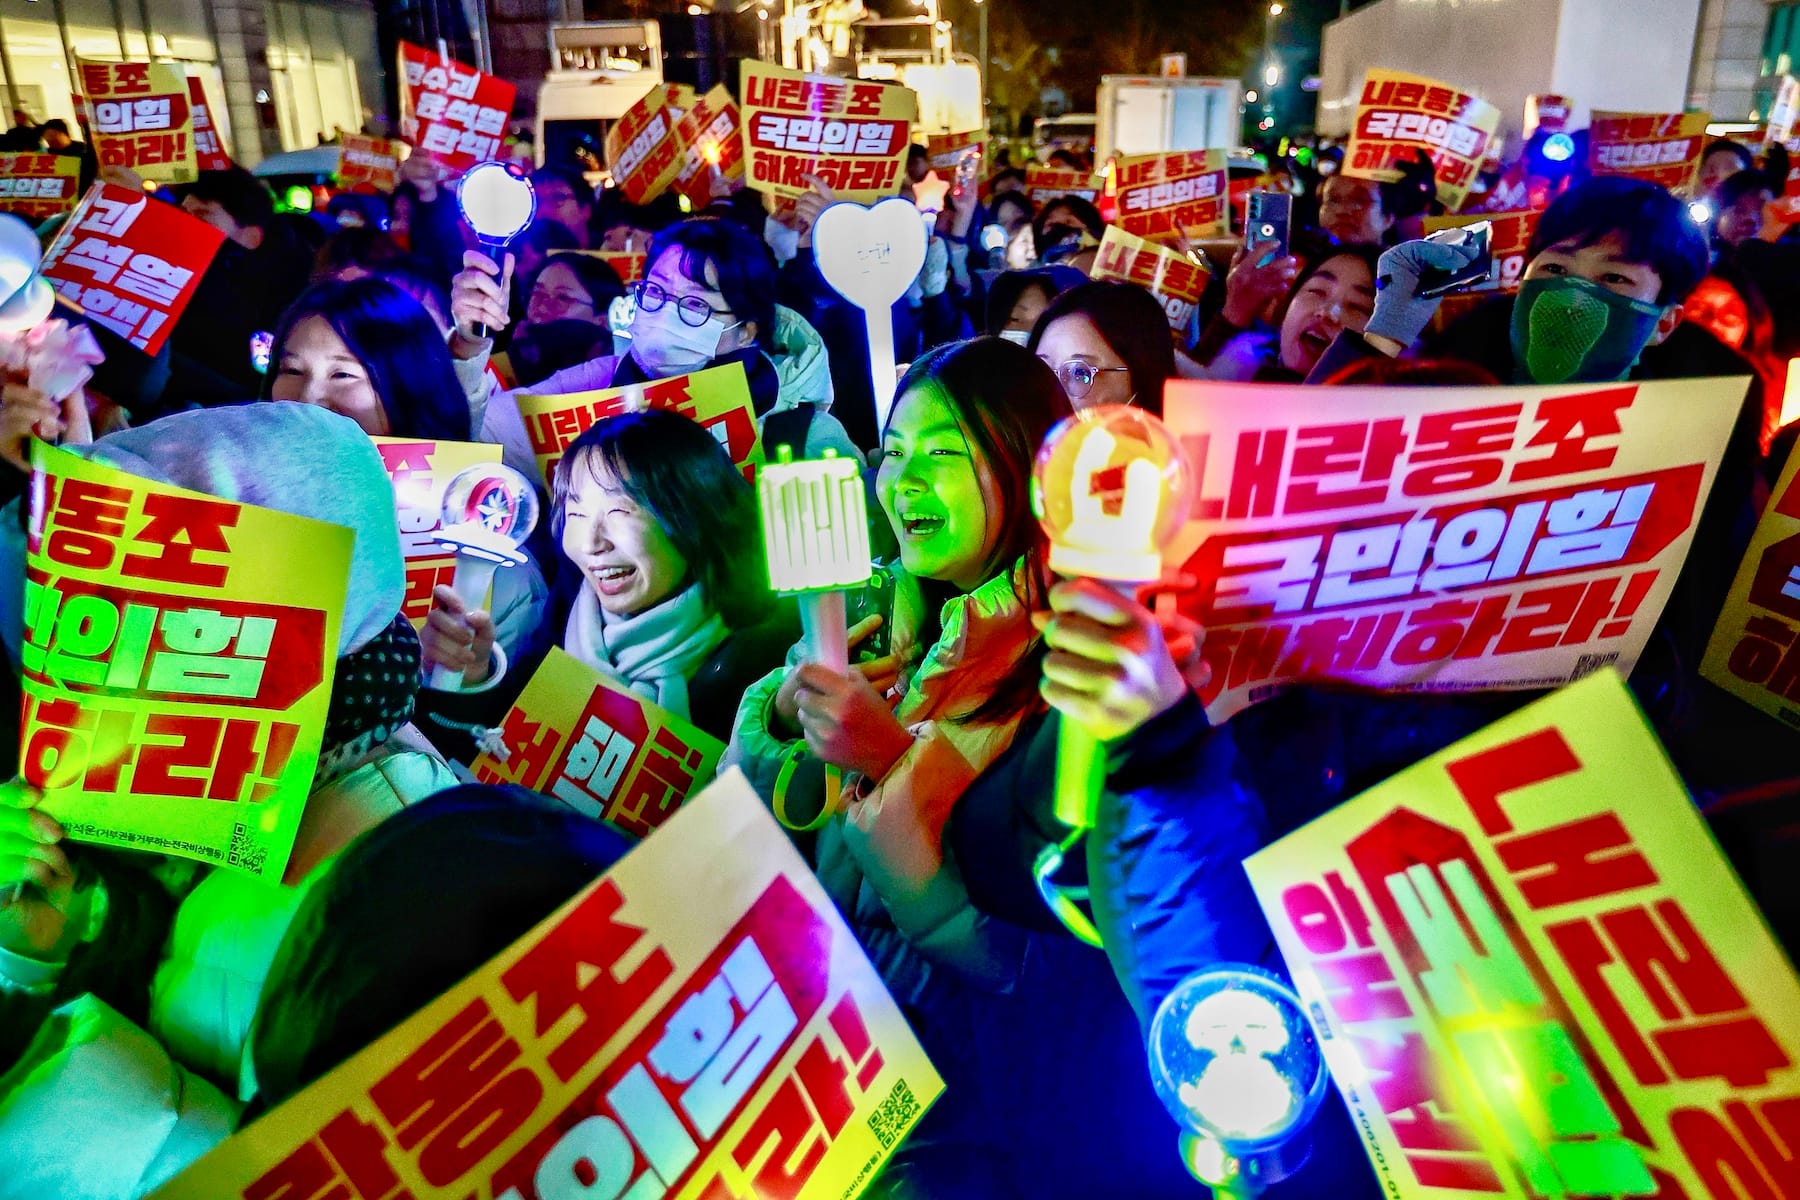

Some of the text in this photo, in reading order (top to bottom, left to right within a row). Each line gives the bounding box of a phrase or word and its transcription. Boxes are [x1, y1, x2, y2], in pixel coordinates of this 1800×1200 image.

[87, 98, 170, 134] 의힘
[746, 75, 884, 116] 내란동조
[757, 115, 895, 155] 국민의힘
[753, 151, 900, 191] 해체하라!
[1352, 143, 1474, 188] 해라!
[1127, 174, 1218, 210] 국민의힘
[1181, 386, 1639, 521] 내란동조
[1213, 483, 1656, 613] 국민의힘
[1198, 569, 1660, 707] 해체하라!
[494, 934, 798, 1200] 의힘
